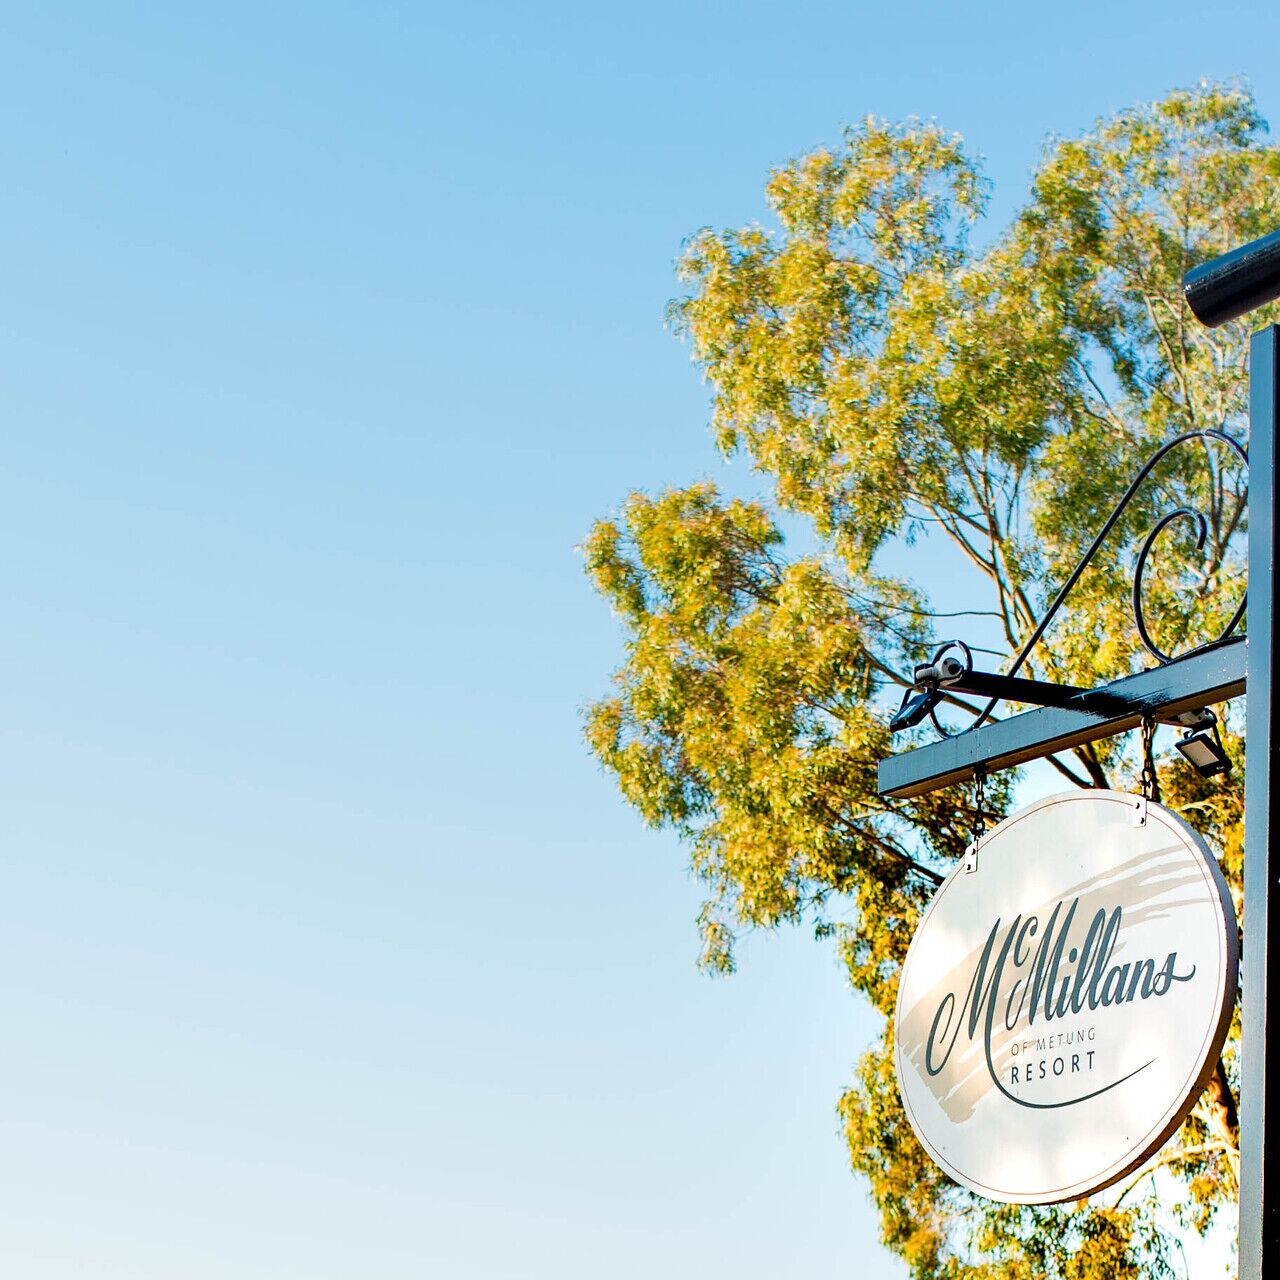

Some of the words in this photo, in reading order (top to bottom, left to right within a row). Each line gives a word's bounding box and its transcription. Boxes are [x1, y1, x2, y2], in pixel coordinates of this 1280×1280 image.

[1010, 1041, 1028, 1056] OF
[1036, 1027, 1096, 1051] METUNG
[1011, 1050, 1096, 1085] RESORT
